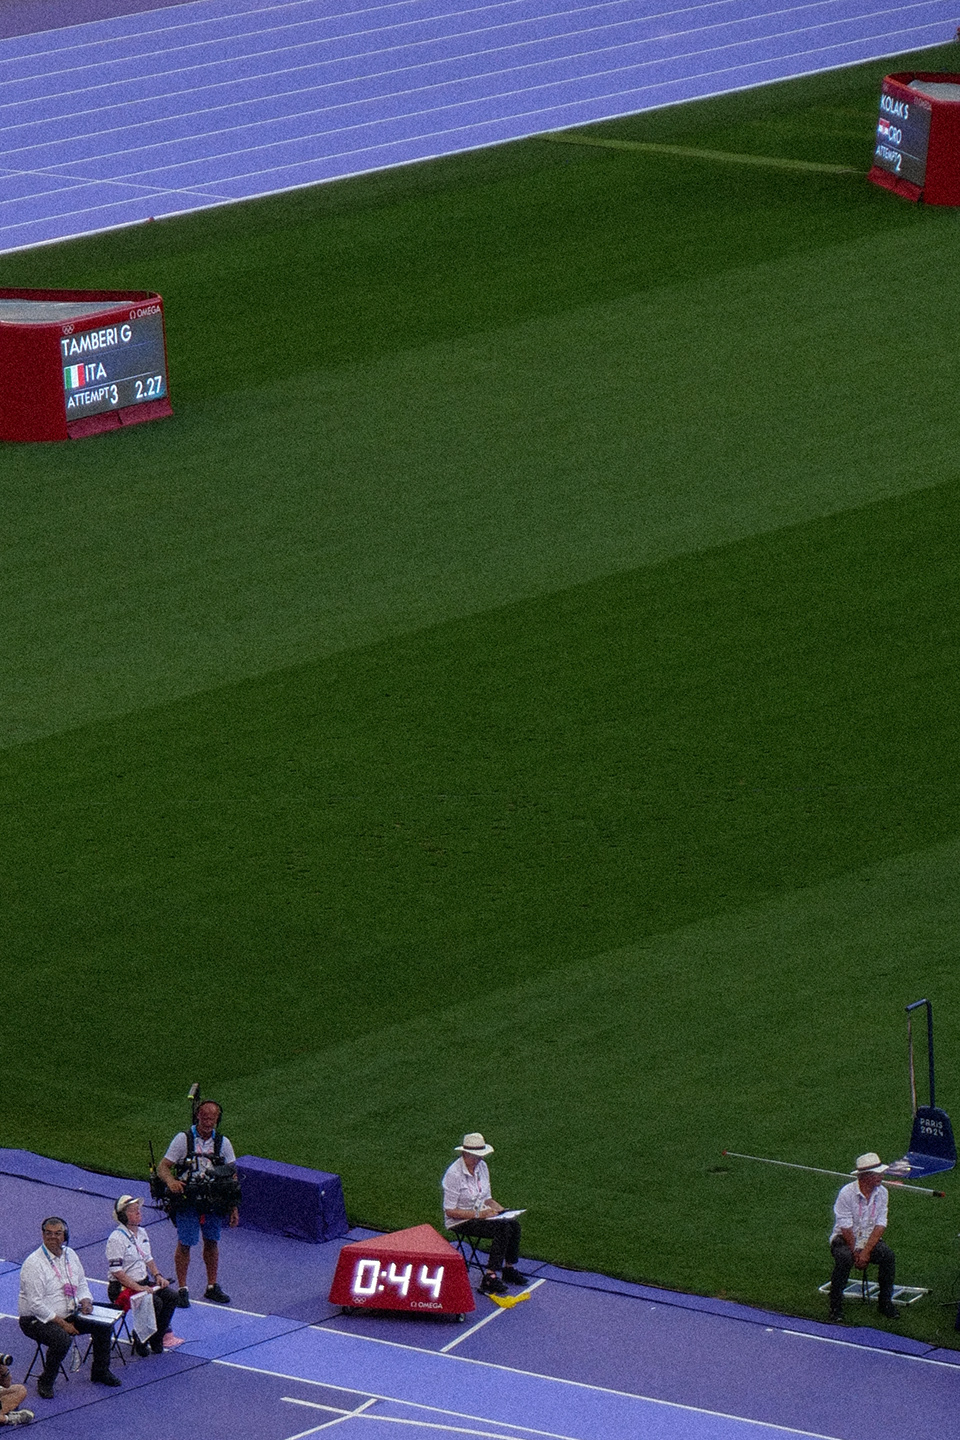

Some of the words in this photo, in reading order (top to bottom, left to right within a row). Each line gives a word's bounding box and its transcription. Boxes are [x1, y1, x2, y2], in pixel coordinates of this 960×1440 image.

[881, 94, 904, 118] KOLAK
[904, 104, 909, 120] S
[895, 153, 902, 171] 2
[137, 305, 161, 319] OMEGA
[61, 327, 119, 357] TAMBERI
[121, 324, 132, 342] G
[85, 362, 107, 382] ITA
[67, 386, 110, 409] ATTEMPT
[110, 384, 119, 404] 3
[135, 375, 162, 399] 2.27
[920, 1117, 943, 1129] PARIS
[920, 1125, 944, 1137] 2024
[352, 1258, 445, 1299] 0:44
[418, 1302, 443, 1310] OMEGA
